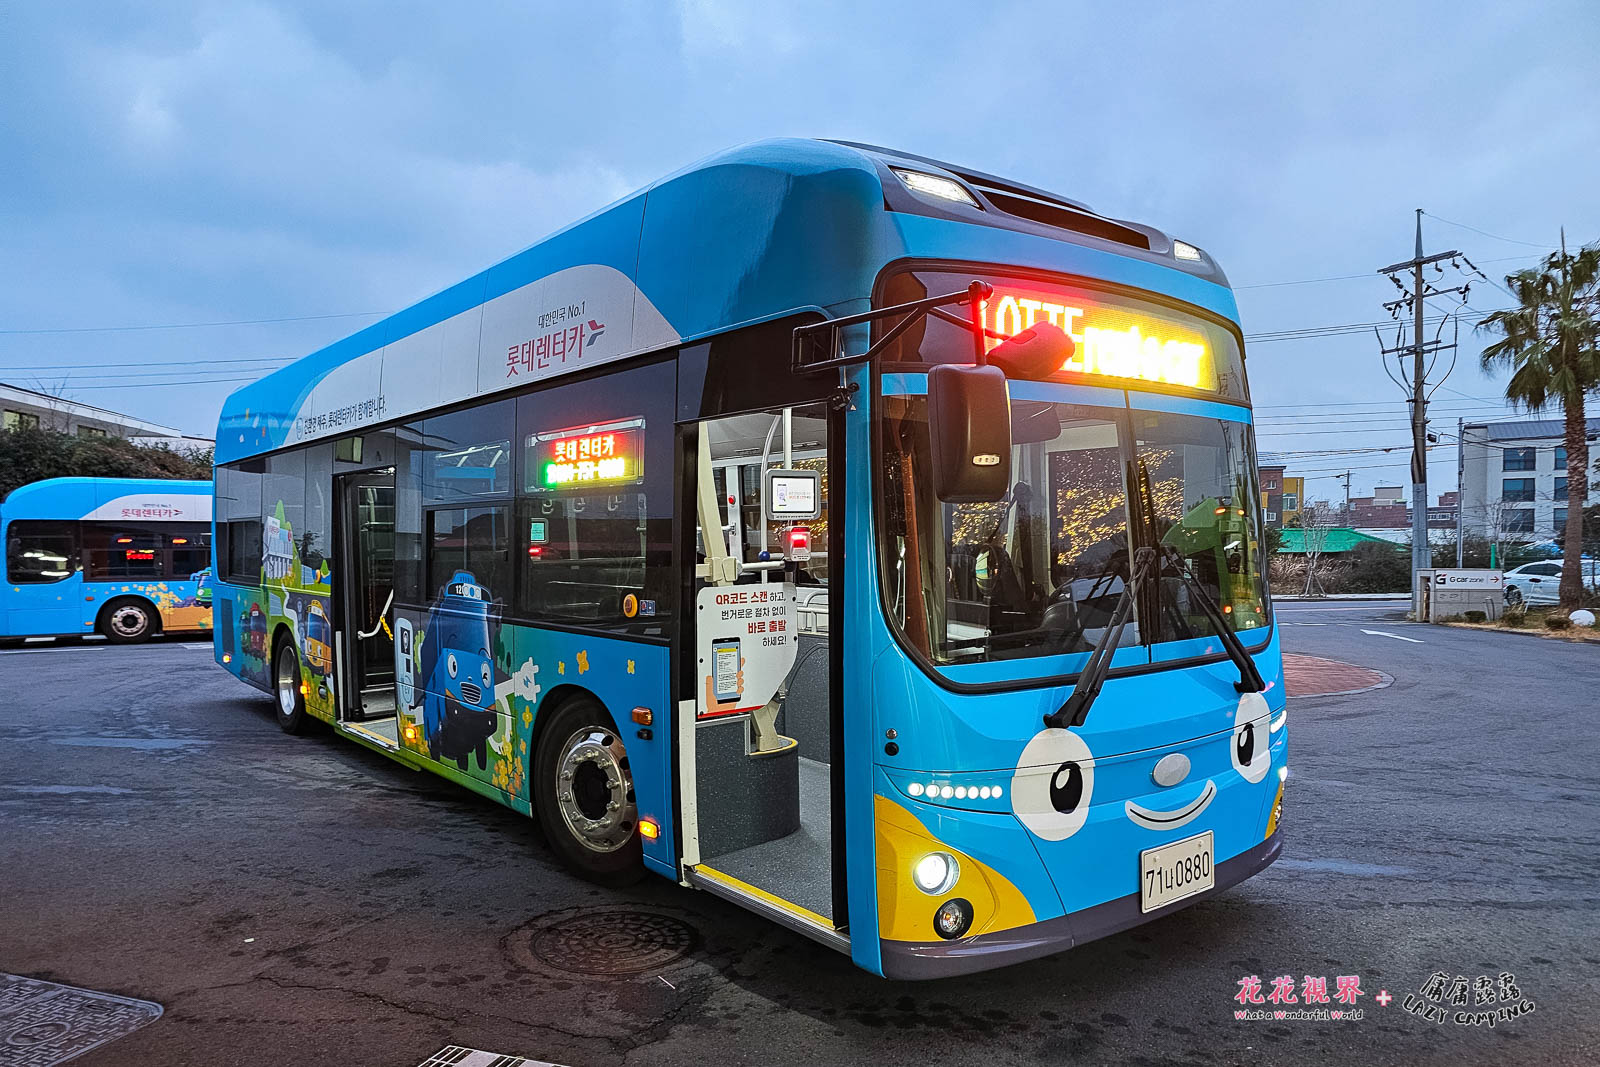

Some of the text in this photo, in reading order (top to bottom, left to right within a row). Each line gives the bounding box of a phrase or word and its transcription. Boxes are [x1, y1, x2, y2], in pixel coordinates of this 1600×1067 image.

[538, 301, 585, 328] 대한민국 No.1
[506, 324, 586, 378] 롯데렌터카
[358, 395, 387, 420] 함께합니다.
[715, 591, 787, 605] QR코드 스캔 하고,
[721, 608, 753, 620] 번거로운
[771, 606, 786, 617] 없이
[747, 619, 787, 634] 바로 출발
[762, 635, 787, 647] 하세요!
[1146, 851, 1209, 898] 71나0880
